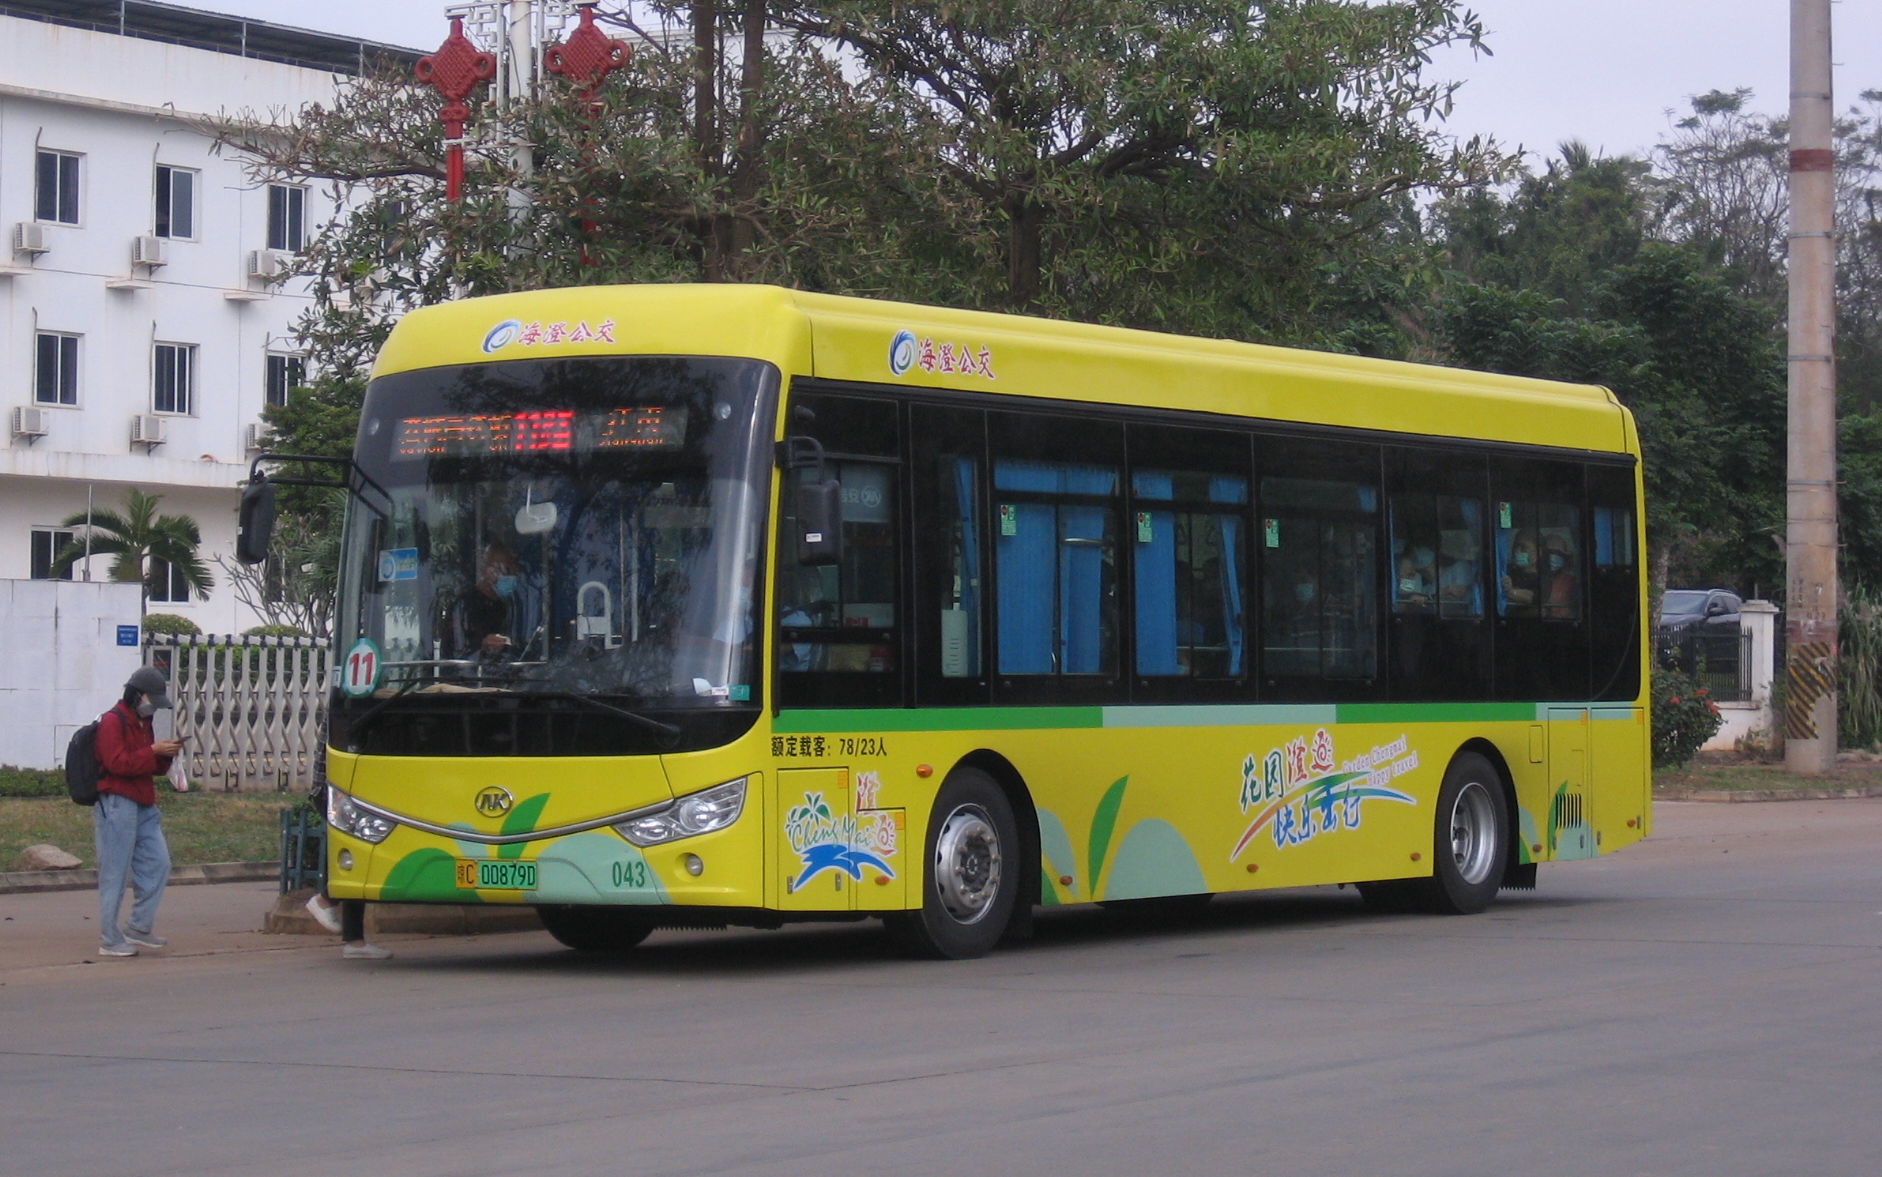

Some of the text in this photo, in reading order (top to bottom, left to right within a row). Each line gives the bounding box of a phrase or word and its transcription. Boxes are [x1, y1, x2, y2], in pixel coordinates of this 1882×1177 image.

[518, 320, 615, 346] 海澄公交
[918, 338, 995, 379] 海澄公交
[349, 652, 374, 687] 11
[611, 861, 646, 888] 043
